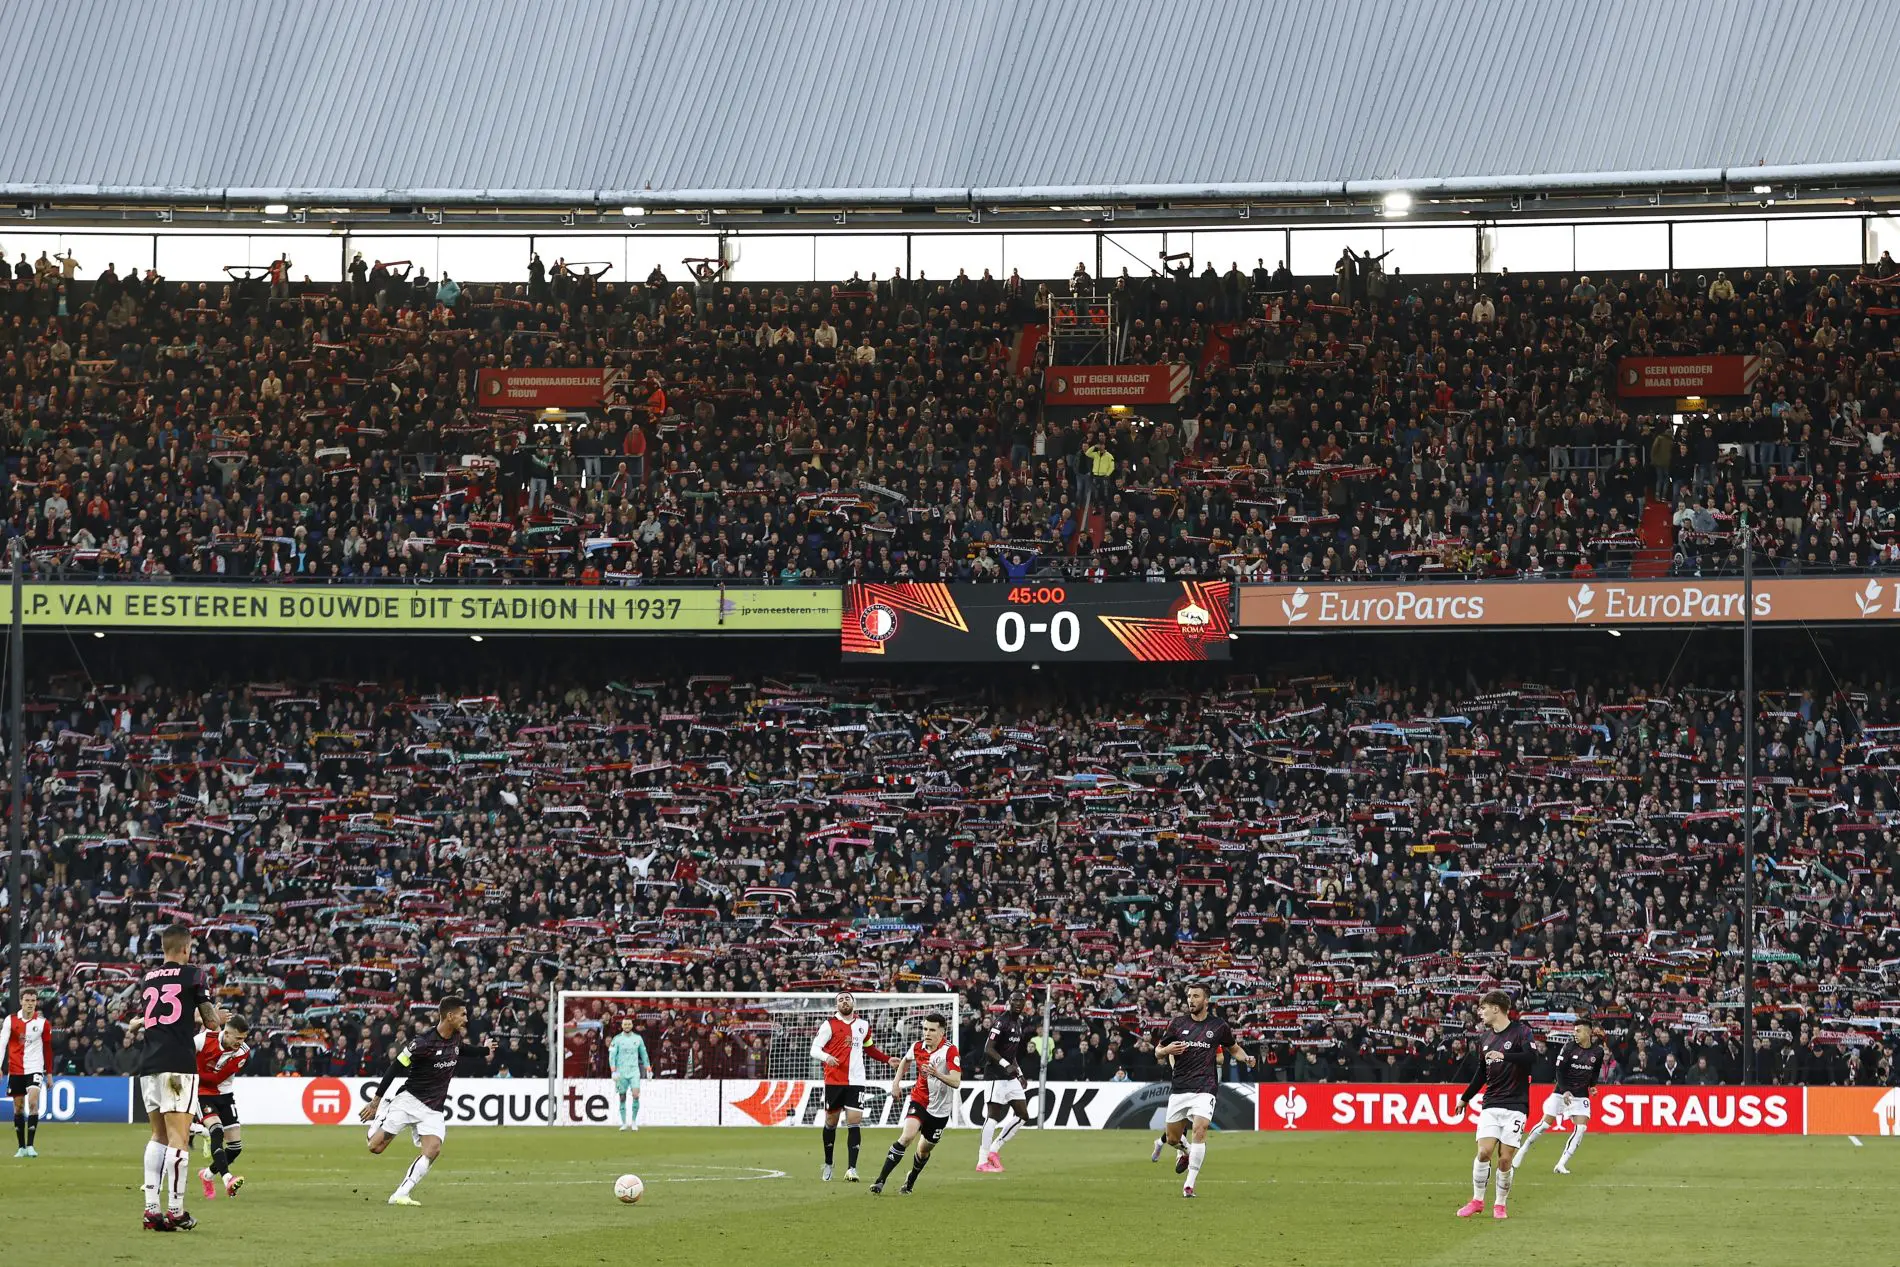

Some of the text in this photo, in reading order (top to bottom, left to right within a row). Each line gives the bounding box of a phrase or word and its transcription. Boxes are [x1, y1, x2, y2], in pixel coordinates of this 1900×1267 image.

[1073, 374, 1150, 384] UIT EIGEN KRACHT
[1645, 365, 1713, 375] GEEN WOORDEN
[1073, 386, 1146, 396] VOORTGEBRACHT
[1645, 377, 1704, 387] MAAR DADEN
[507, 389, 538, 398] TROUW
[1007, 586, 1066, 605] 45:00
[1605, 587, 1772, 618] EuroParcs
[59, 593, 112, 616] VAN
[125, 594, 268, 618] EESTEREN
[280, 596, 399, 619] BOUWDE
[410, 596, 453, 619] DIT
[461, 597, 578, 621] STADION
[588, 597, 616, 620] IN
[624, 597, 682, 621] 1937
[1318, 591, 1484, 621] EuroParcs
[1181, 626, 1205, 634] ROMA
[142, 983, 183, 1030] 23
[1332, 1092, 1485, 1125] STRAUS
[1600, 1094, 1789, 1127] STRAUSS
